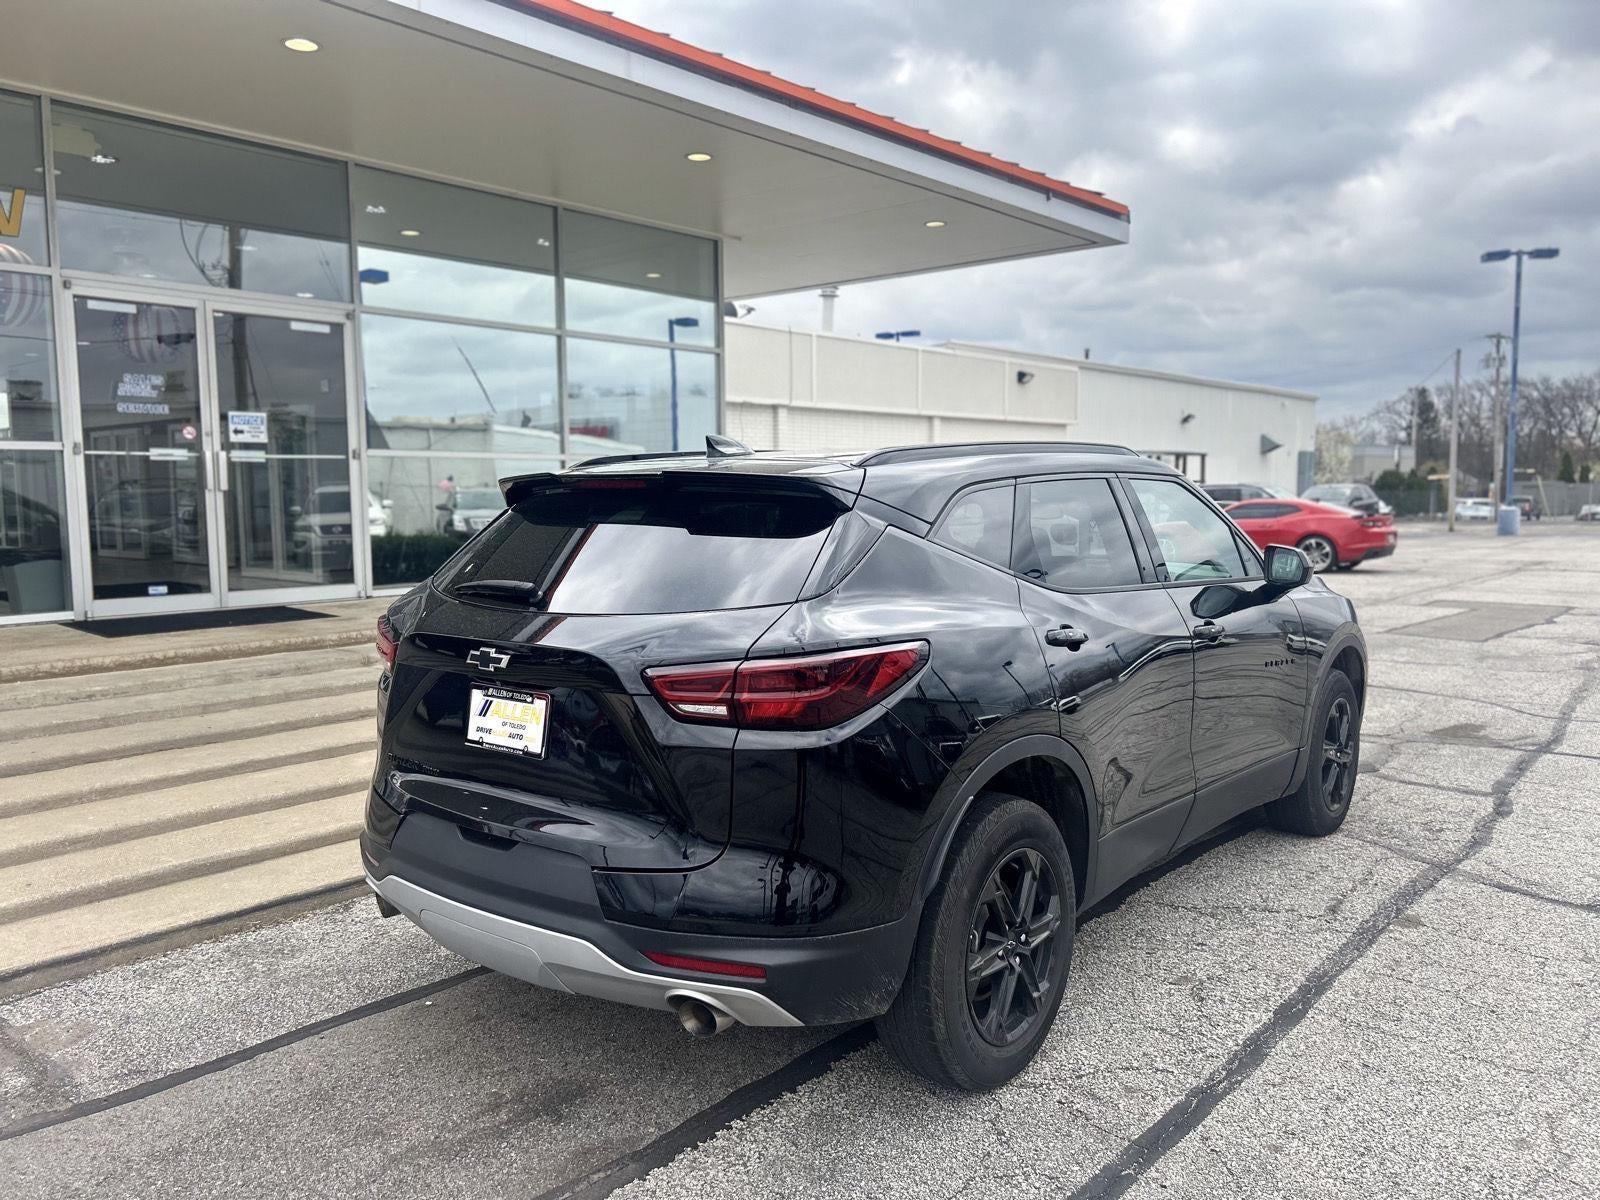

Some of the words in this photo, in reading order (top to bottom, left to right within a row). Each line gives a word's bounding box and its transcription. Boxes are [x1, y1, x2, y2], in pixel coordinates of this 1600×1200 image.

[233, 416, 262, 425] NOTICE
[490, 701, 543, 725] ALLEN
[508, 722, 527, 731] TOLEDO
